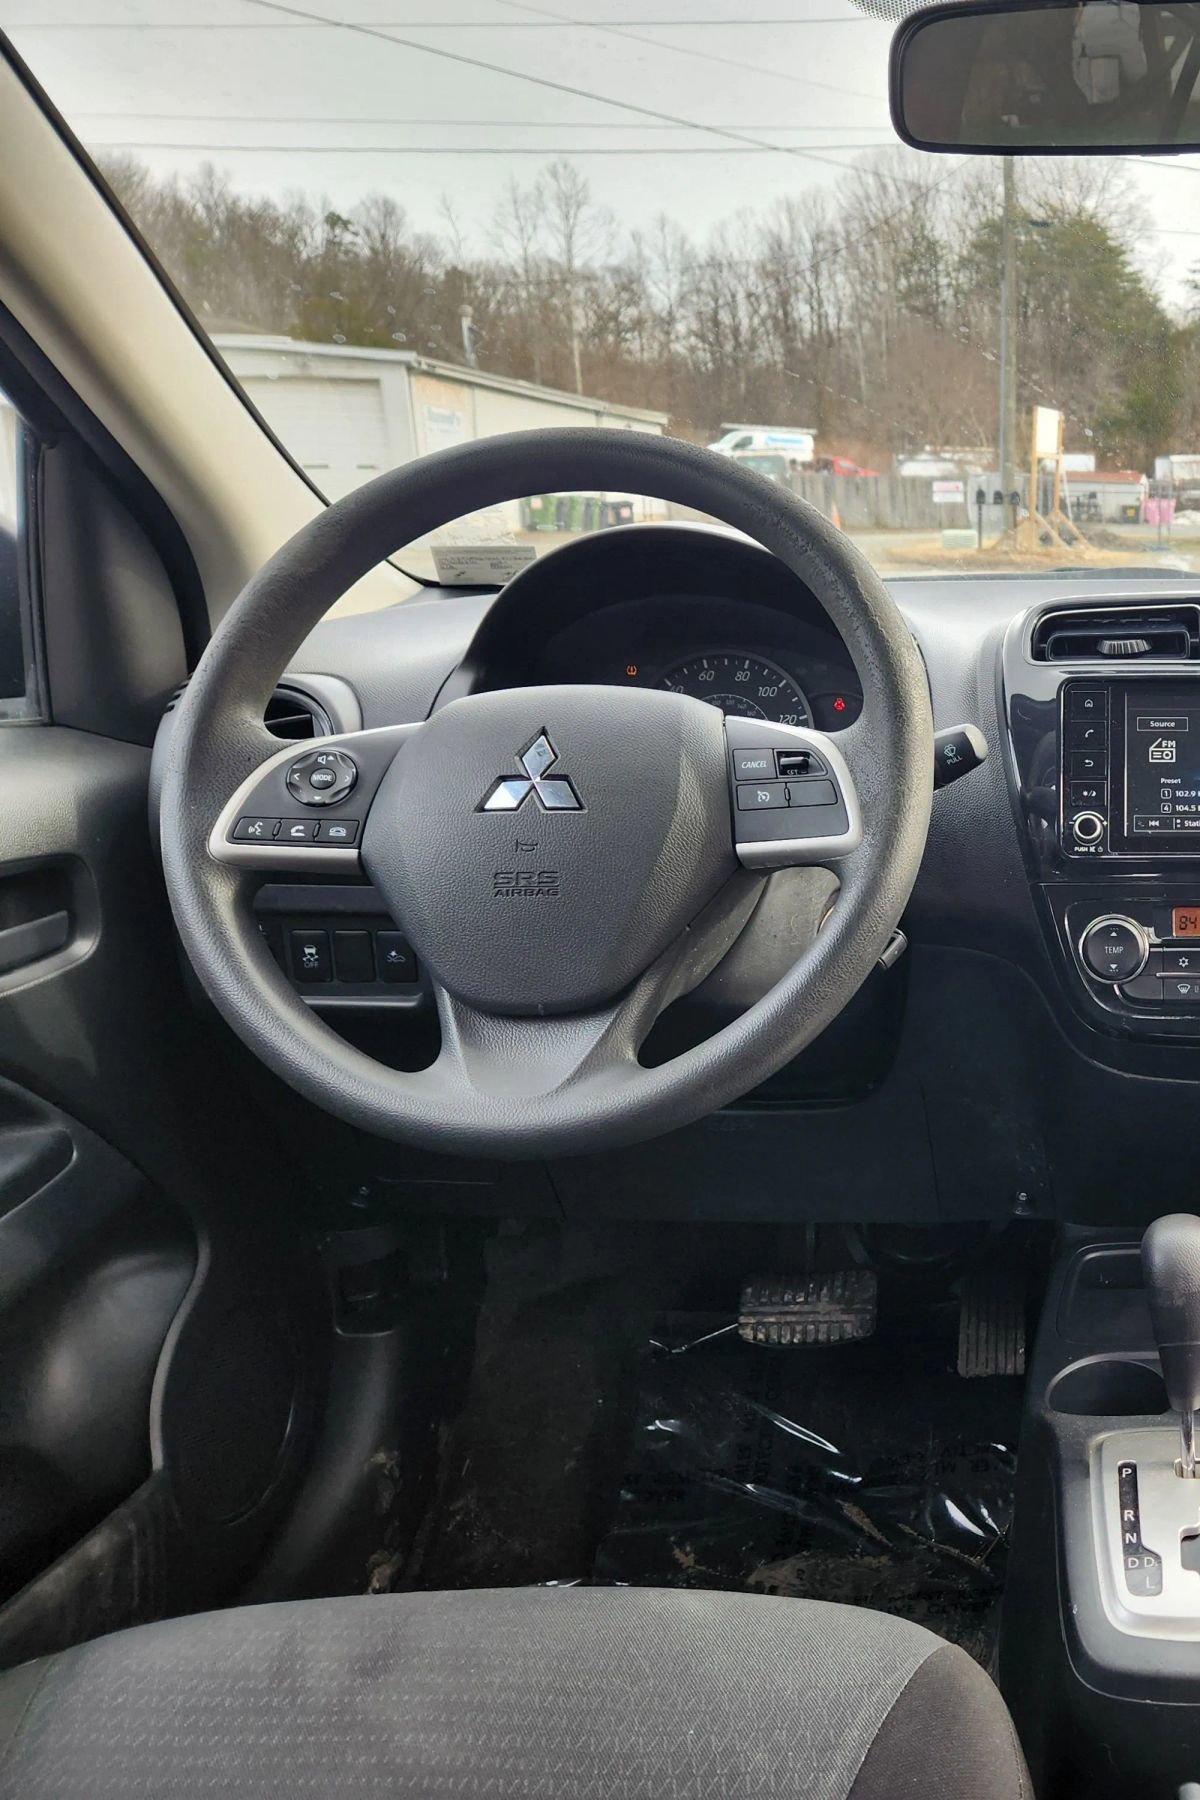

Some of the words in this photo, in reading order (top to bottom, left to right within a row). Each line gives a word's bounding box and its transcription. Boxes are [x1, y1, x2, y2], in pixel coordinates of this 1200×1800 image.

[698, 670, 715, 681] 60
[734, 670, 751, 681] 80
[757, 686, 778, 697] 100
[779, 714, 798, 725] 120
[1150, 720, 1176, 728] Source
[1162, 740, 1176, 748] FM
[741, 760, 767, 769] CANCEL
[946, 755, 964, 765] PULL
[312, 774, 334, 782] MODE
[493, 871, 560, 888] SRS
[493, 888, 560, 897] AIRBAG
[1179, 915, 1198, 930] 84
[1104, 945, 1124, 955] TEMP
[304, 961, 319, 969] OFF
[1122, 1468, 1132, 1478] P
[1124, 1510, 1135, 1521] R
[1125, 1533, 1137, 1544] N
[1128, 1557, 1140, 1568] D
[1146, 1576, 1156, 1589] L
